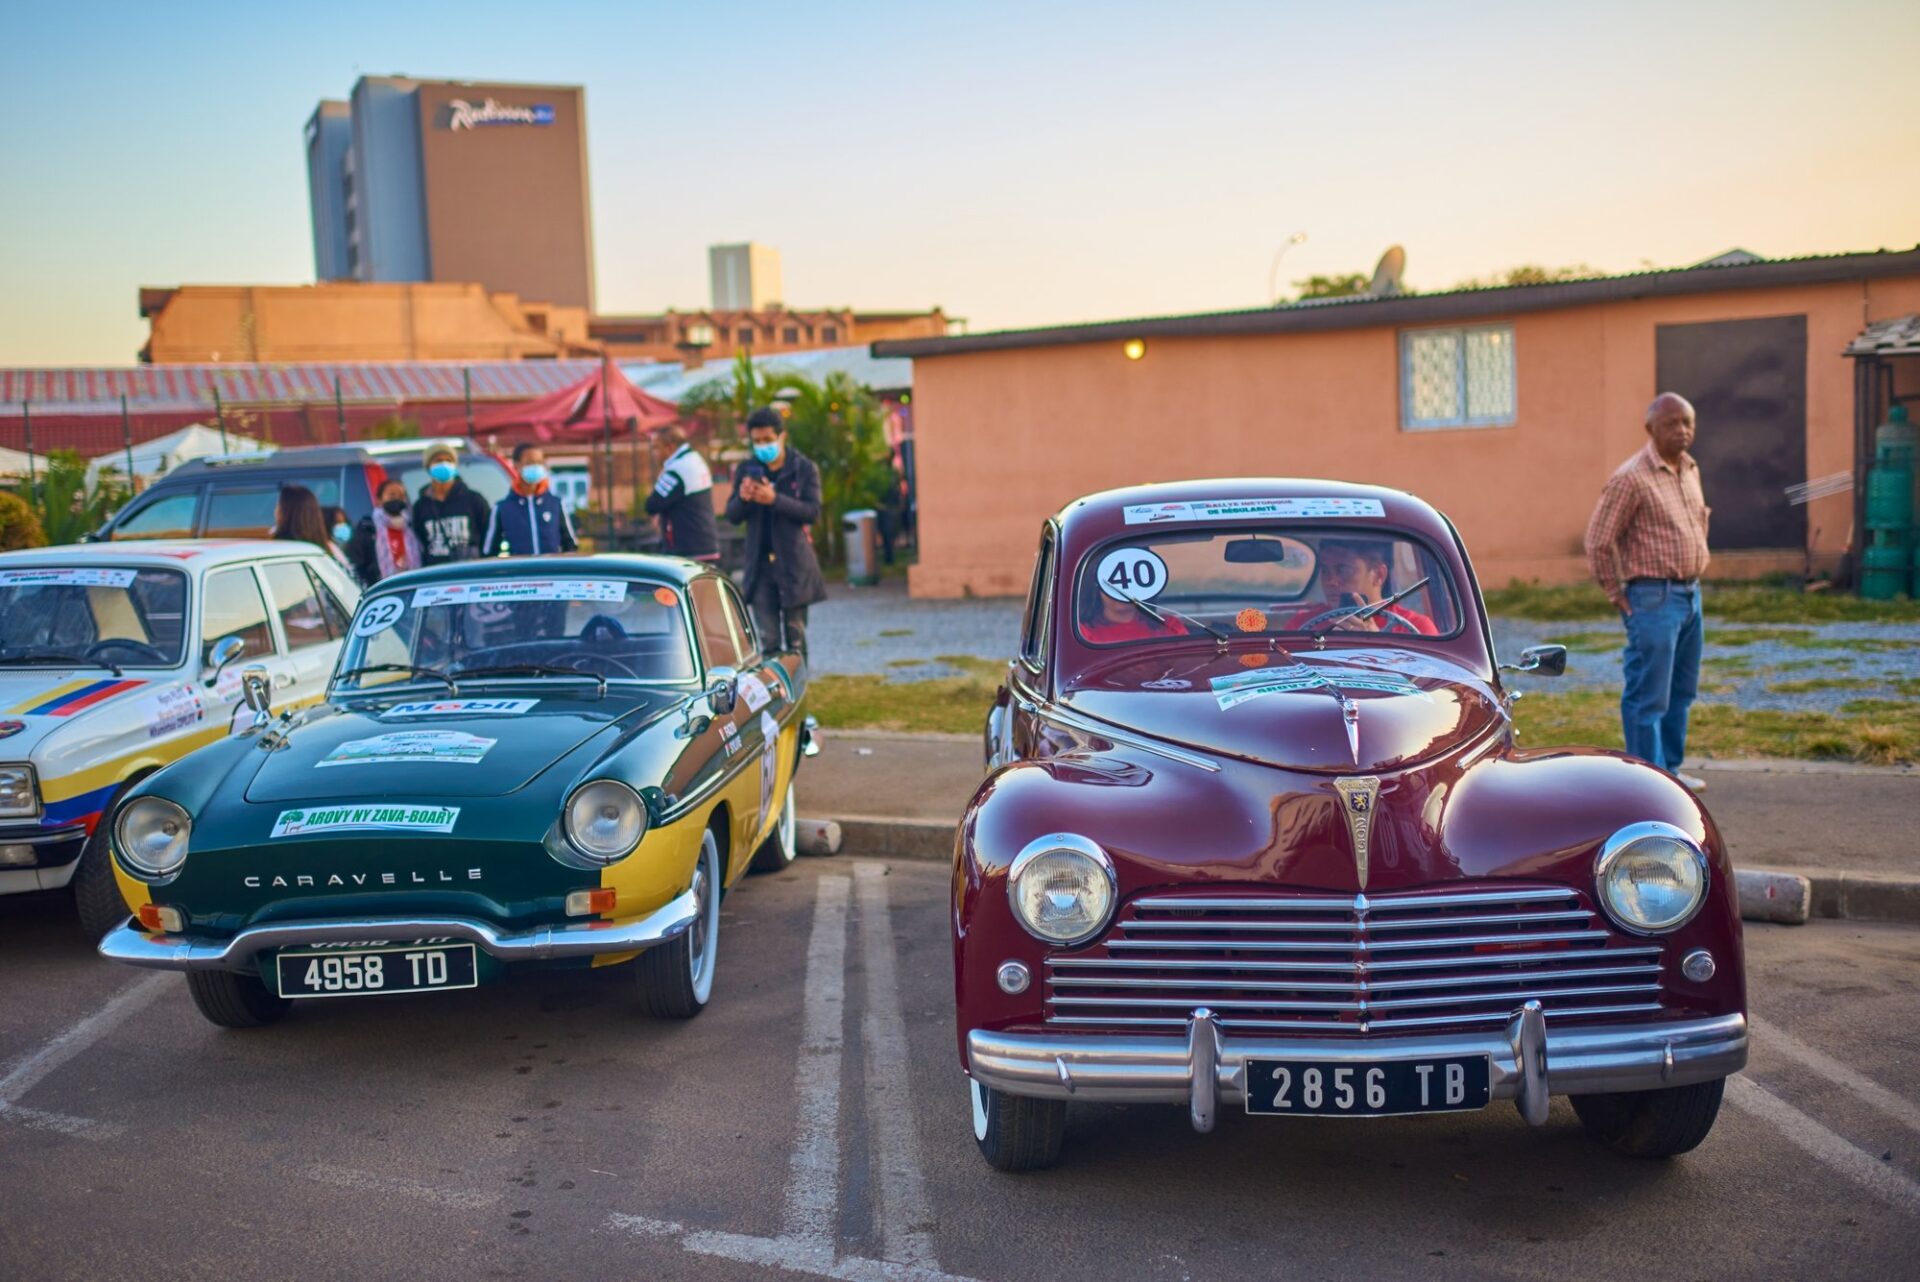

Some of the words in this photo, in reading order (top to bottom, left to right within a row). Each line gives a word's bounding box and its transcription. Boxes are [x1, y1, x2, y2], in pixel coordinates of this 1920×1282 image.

[1108, 559, 1156, 589] 40
[361, 603, 398, 628] 62
[394, 701, 520, 712] Mobil
[306, 809, 351, 826] AROVY
[352, 808, 370, 822] NY
[372, 807, 456, 825] ZAVA-BOARY
[243, 868, 482, 888] CARAVELLE
[304, 956, 384, 991] 4958
[405, 952, 448, 986] TD
[1272, 1067, 1386, 1109] 2856
[1415, 1063, 1465, 1106] TB
